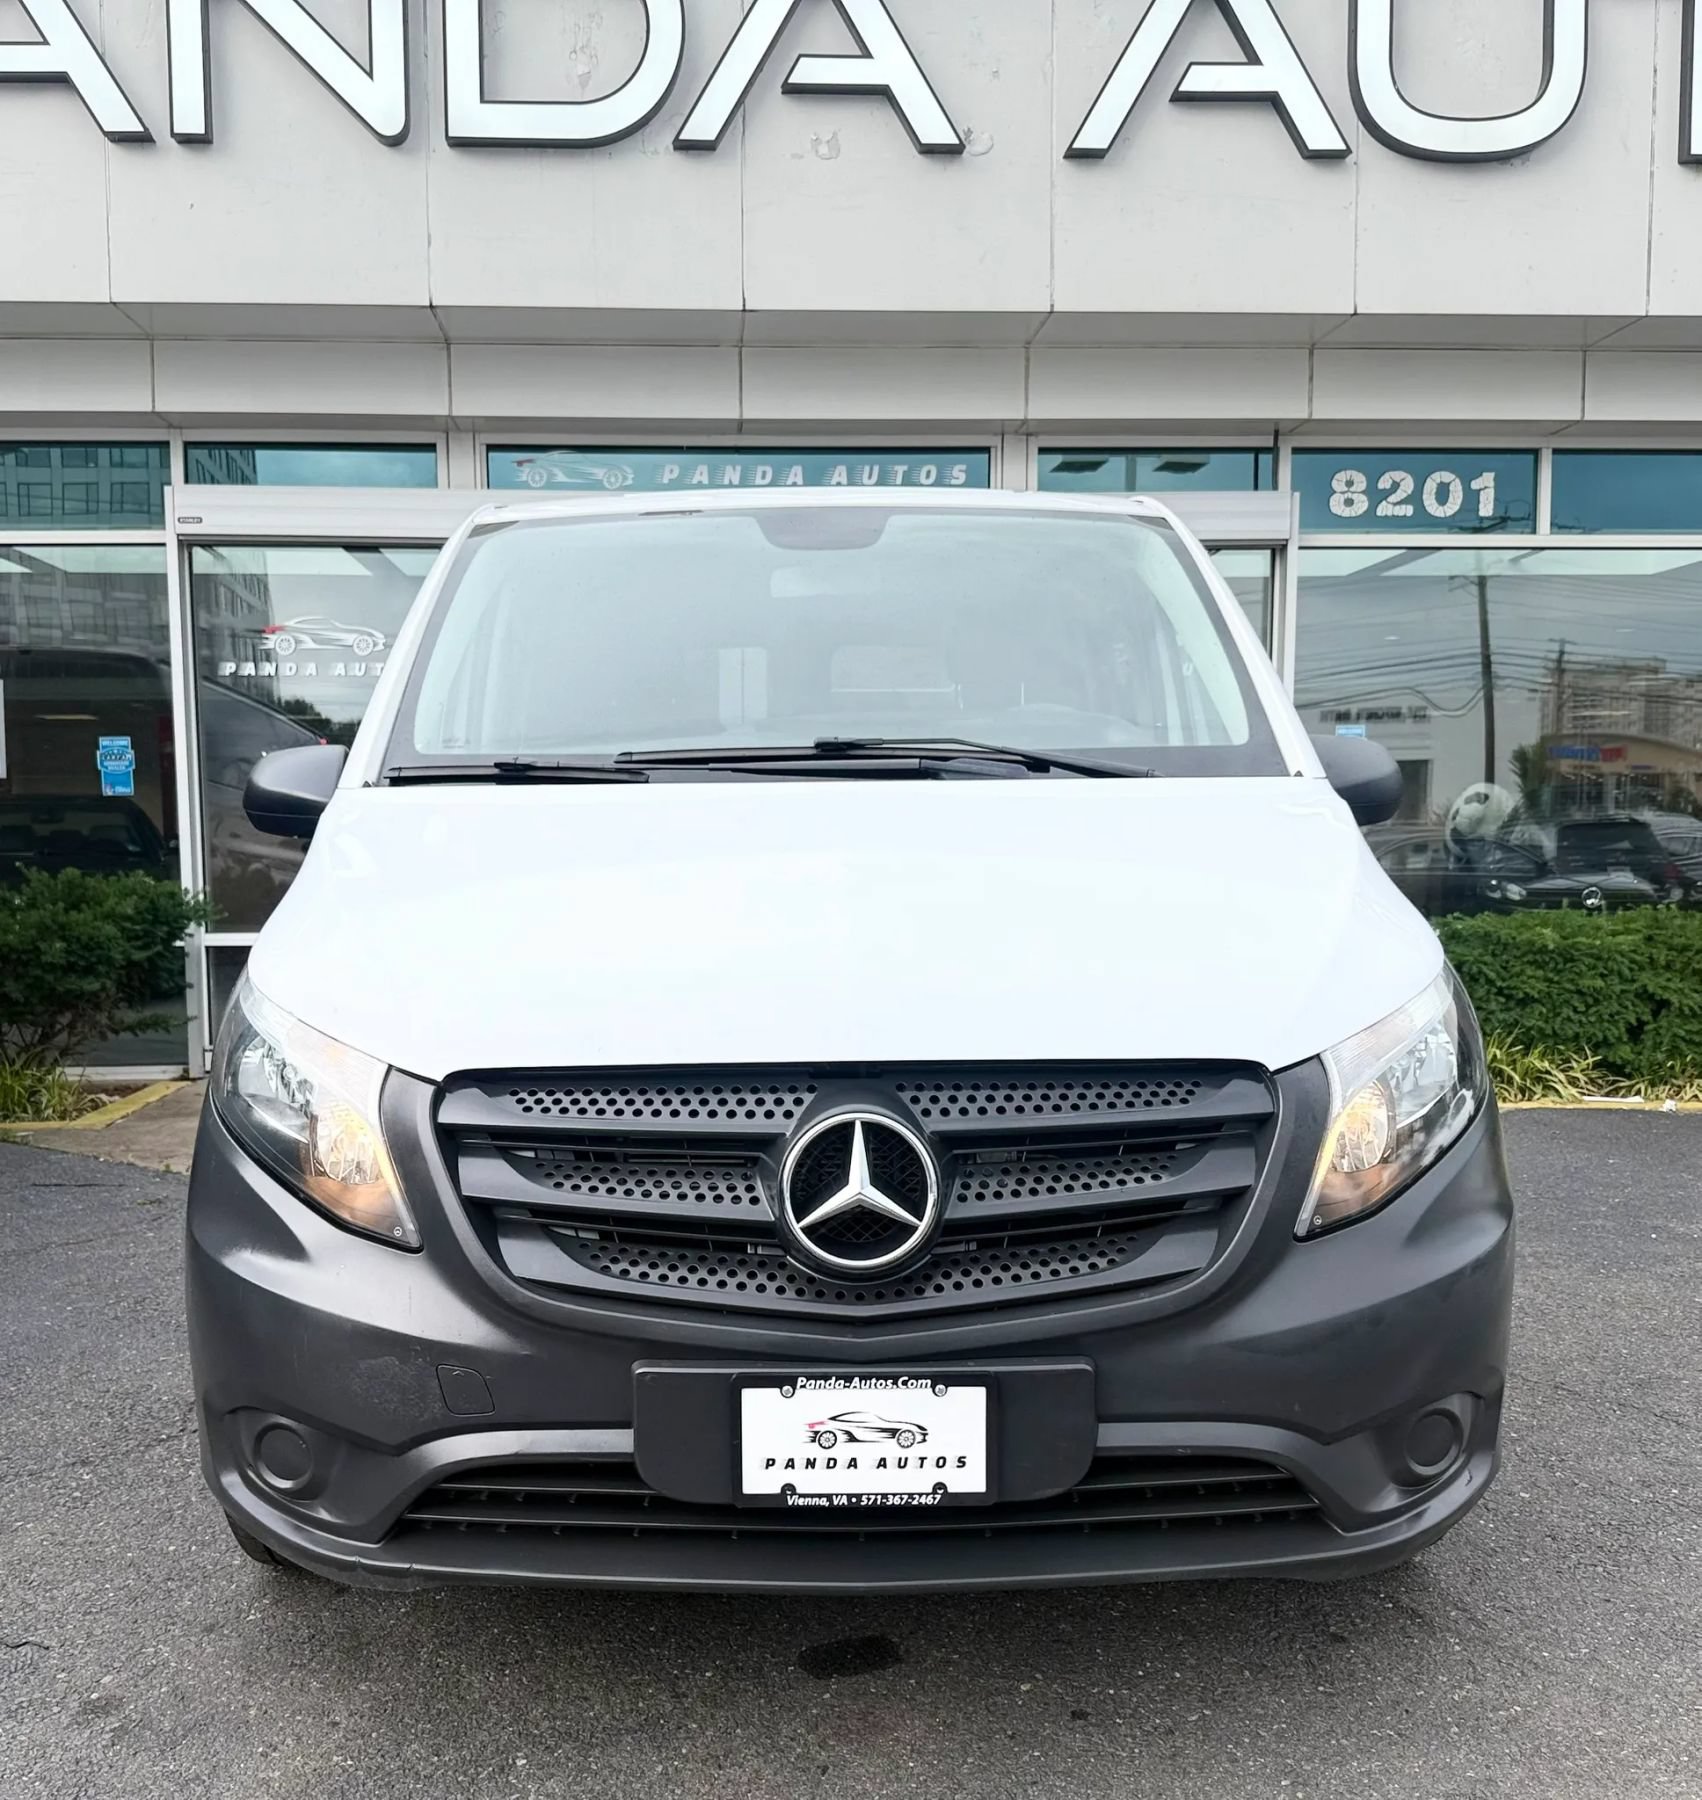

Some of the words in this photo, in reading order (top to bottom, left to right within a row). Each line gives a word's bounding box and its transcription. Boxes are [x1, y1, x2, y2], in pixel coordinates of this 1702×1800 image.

[1063, 0, 1702, 164] AU
[660, 464, 804, 485] PANDA
[829, 464, 967, 485] AUTOS
[1329, 470, 1495, 518] 8201
[222, 661, 318, 677] PANDA
[796, 1376, 932, 1390] Panda-Autos.Com
[764, 1457, 858, 1470] PANDA
[876, 1456, 967, 1469] AUTOS
[787, 1495, 830, 1507] Vienna,
[832, 1496, 848, 1506] VA
[860, 1495, 942, 1506] 571-367-2467
